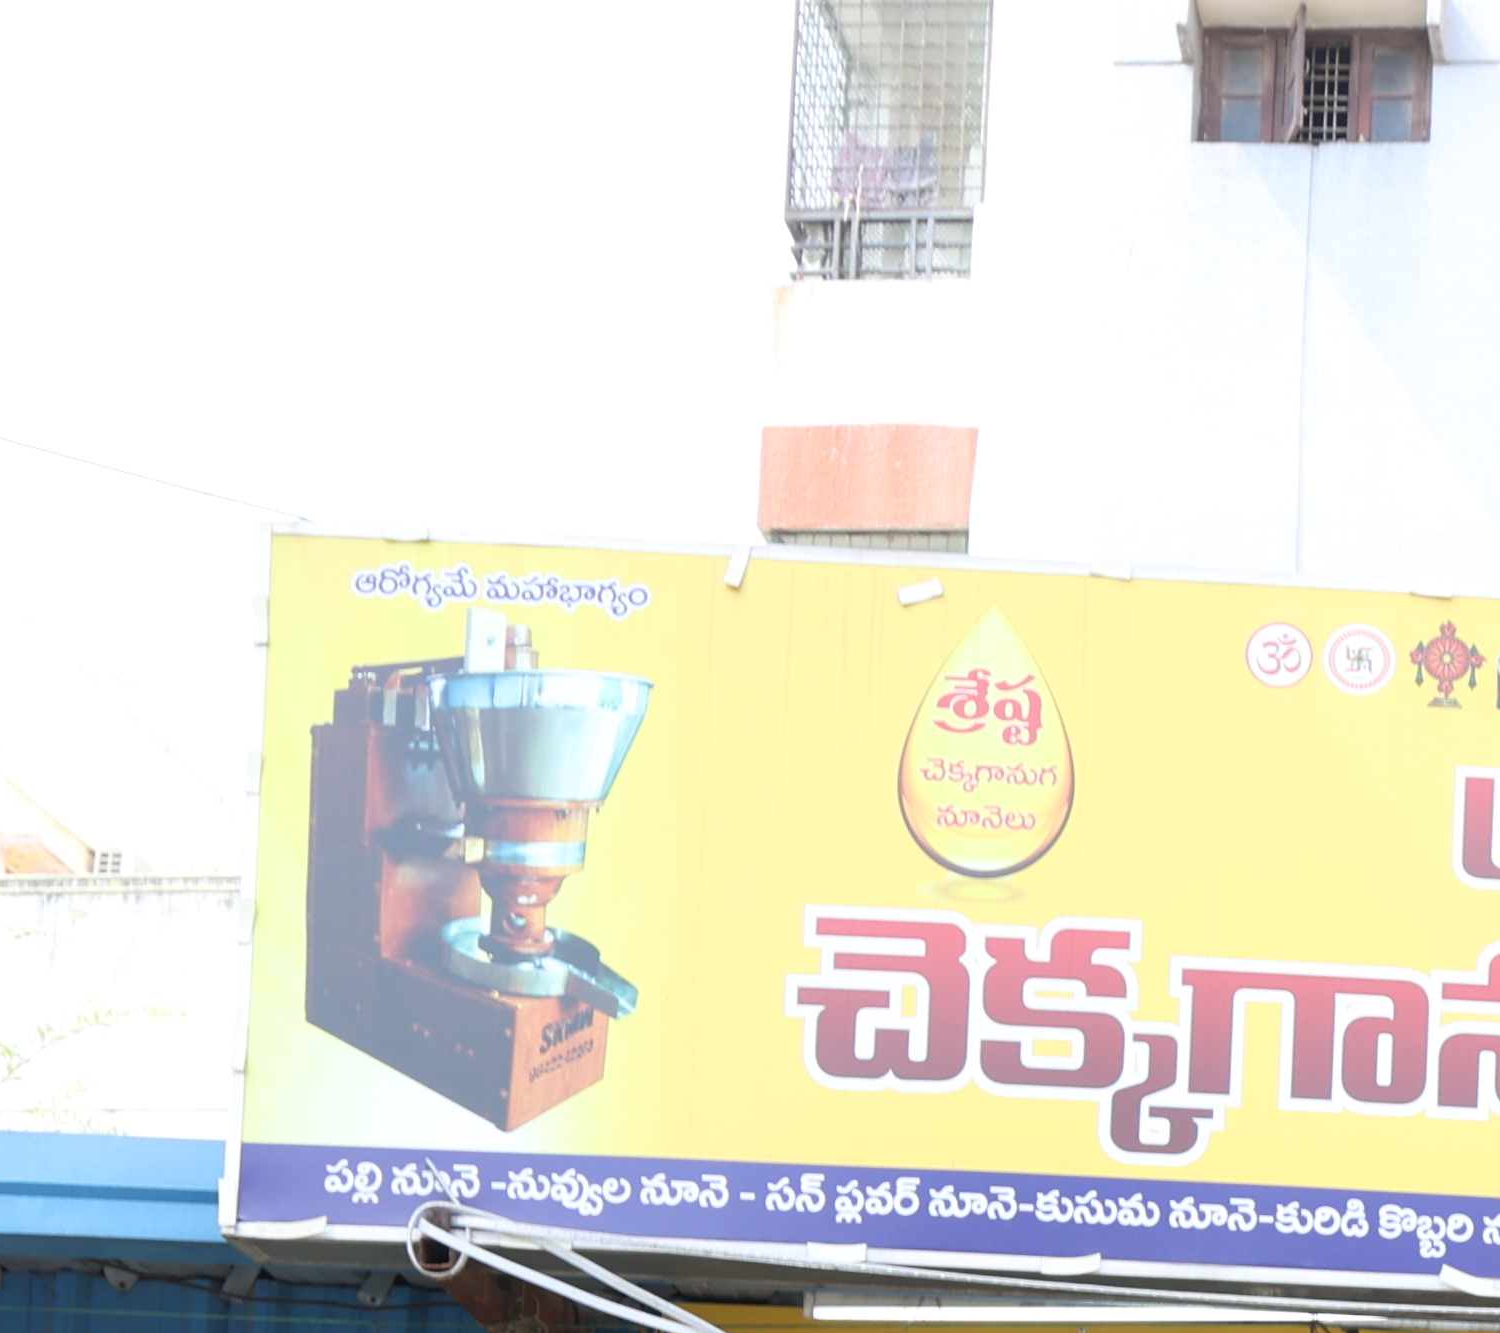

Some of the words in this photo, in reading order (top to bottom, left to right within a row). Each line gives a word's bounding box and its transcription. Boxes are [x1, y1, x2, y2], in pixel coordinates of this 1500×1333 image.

[355, 565, 478, 607] ఆరోగ్యమే
[486, 574, 649, 617] మహాభాగ్యం
[920, 757, 1057, 793] చెక్కగానుగ
[936, 804, 1036, 830] నూనెలు
[324, 1159, 382, 1205] పల్లి
[391, 1161, 480, 1199] నూనె
[640, 1173, 729, 1207] నూనె
[765, 1173, 826, 1213] సన్
[1378, 1205, 1474, 1259] కొబ్బరి
